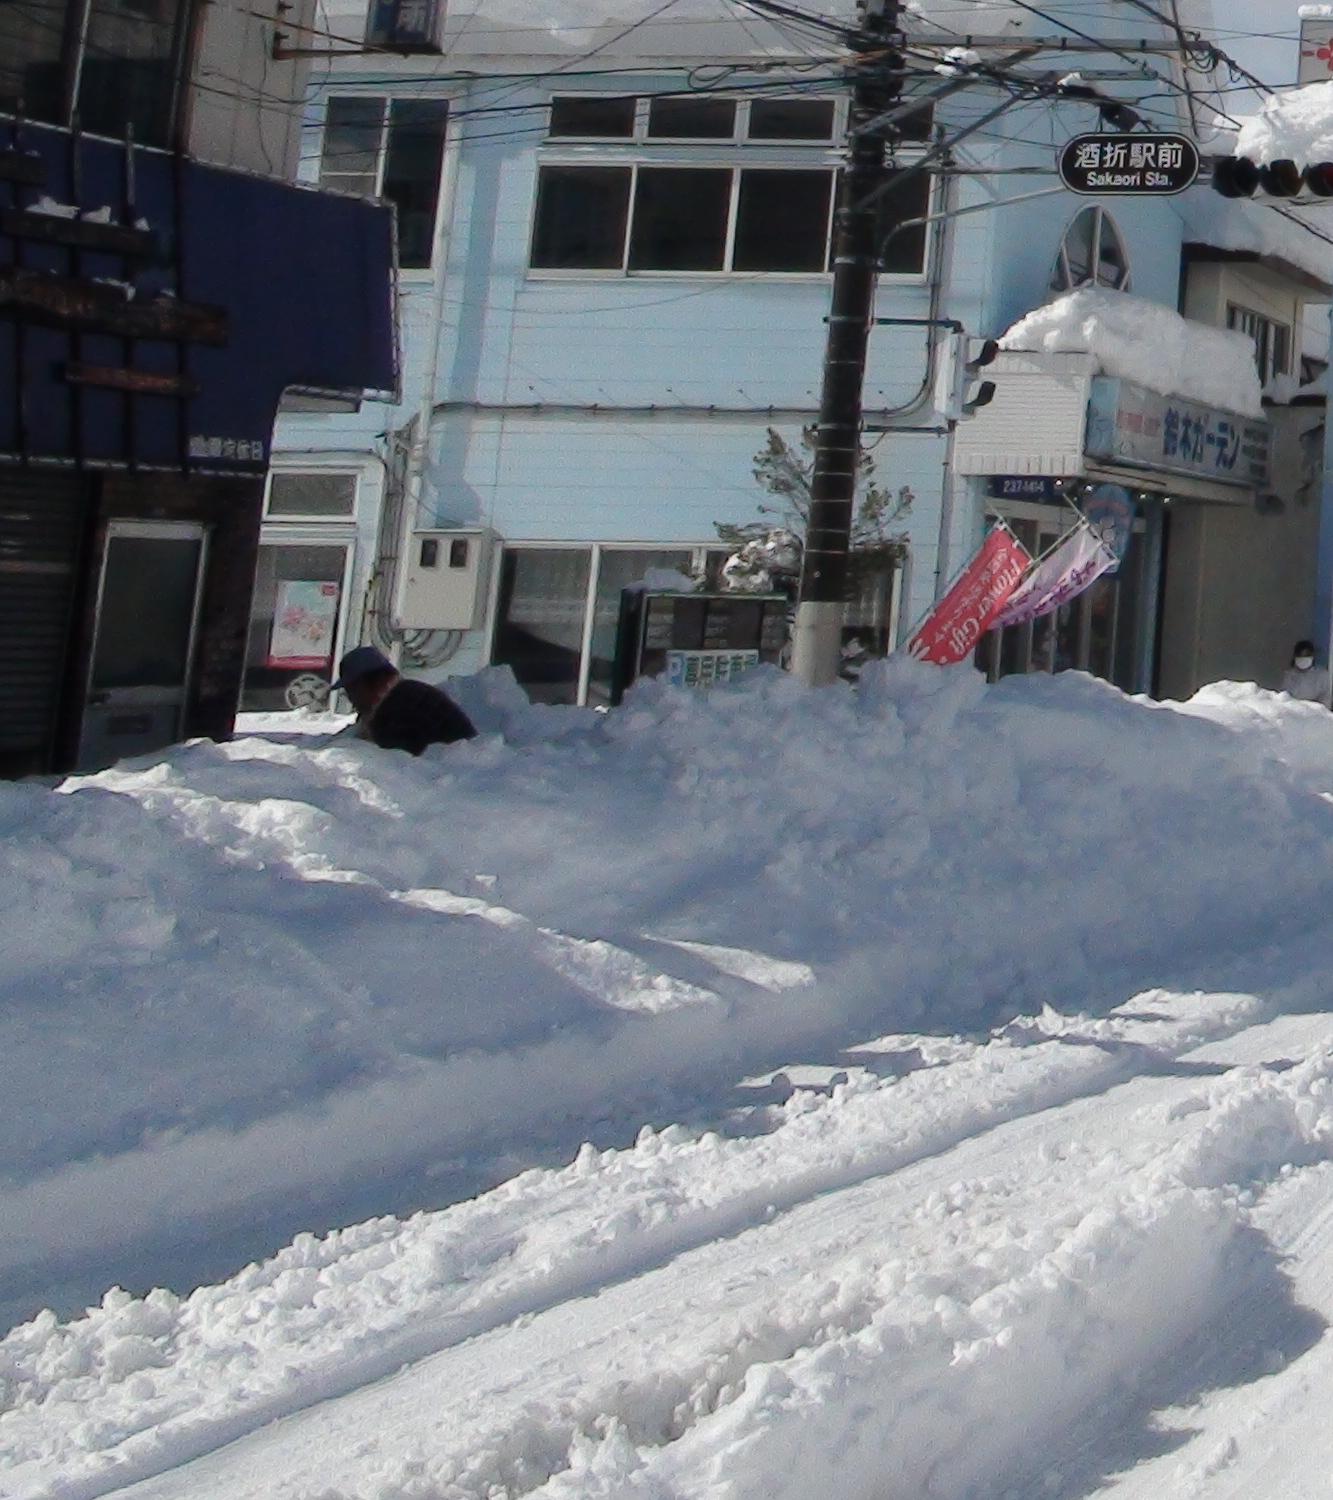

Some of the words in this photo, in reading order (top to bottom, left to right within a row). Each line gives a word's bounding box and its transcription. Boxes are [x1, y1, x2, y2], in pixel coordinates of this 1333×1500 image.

[1074, 142, 1184, 169] 酒折駅前
[1087, 171, 1141, 187] Sakaori
[1145, 171, 1173, 186] Sta.
[1163, 406, 1242, 471] 鈴木ガーデン
[979, 557, 1024, 619] Flower
[949, 616, 981, 655] Gift
